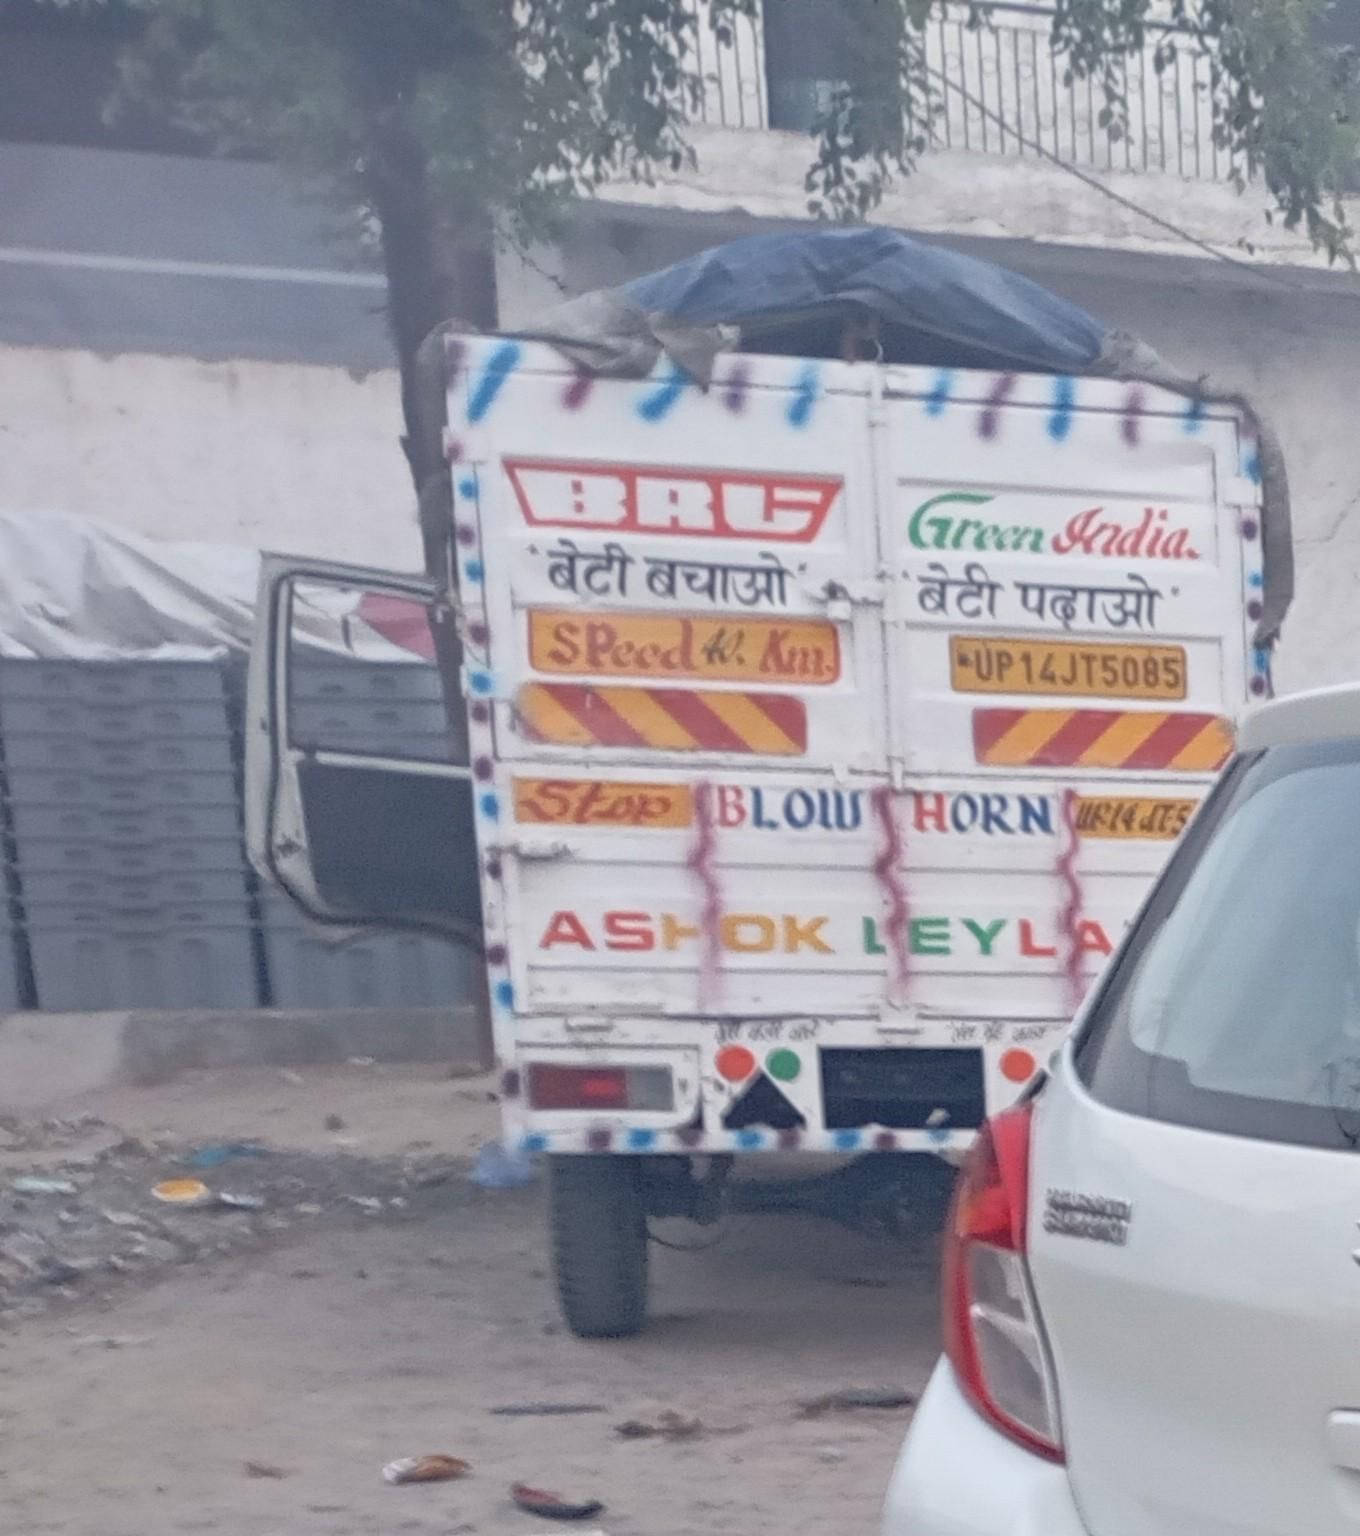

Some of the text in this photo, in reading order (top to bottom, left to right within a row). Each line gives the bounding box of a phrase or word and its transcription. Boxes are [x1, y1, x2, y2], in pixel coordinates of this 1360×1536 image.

[908, 493, 1045, 553] Green
[546, 538, 796, 605] बेटी बचाओ
[917, 562, 1004, 618] बेटी
[716, 785, 865, 831] BLOW
[912, 792, 1056, 836] HORN
[538, 910, 1116, 957] ASHOK LEYLA
